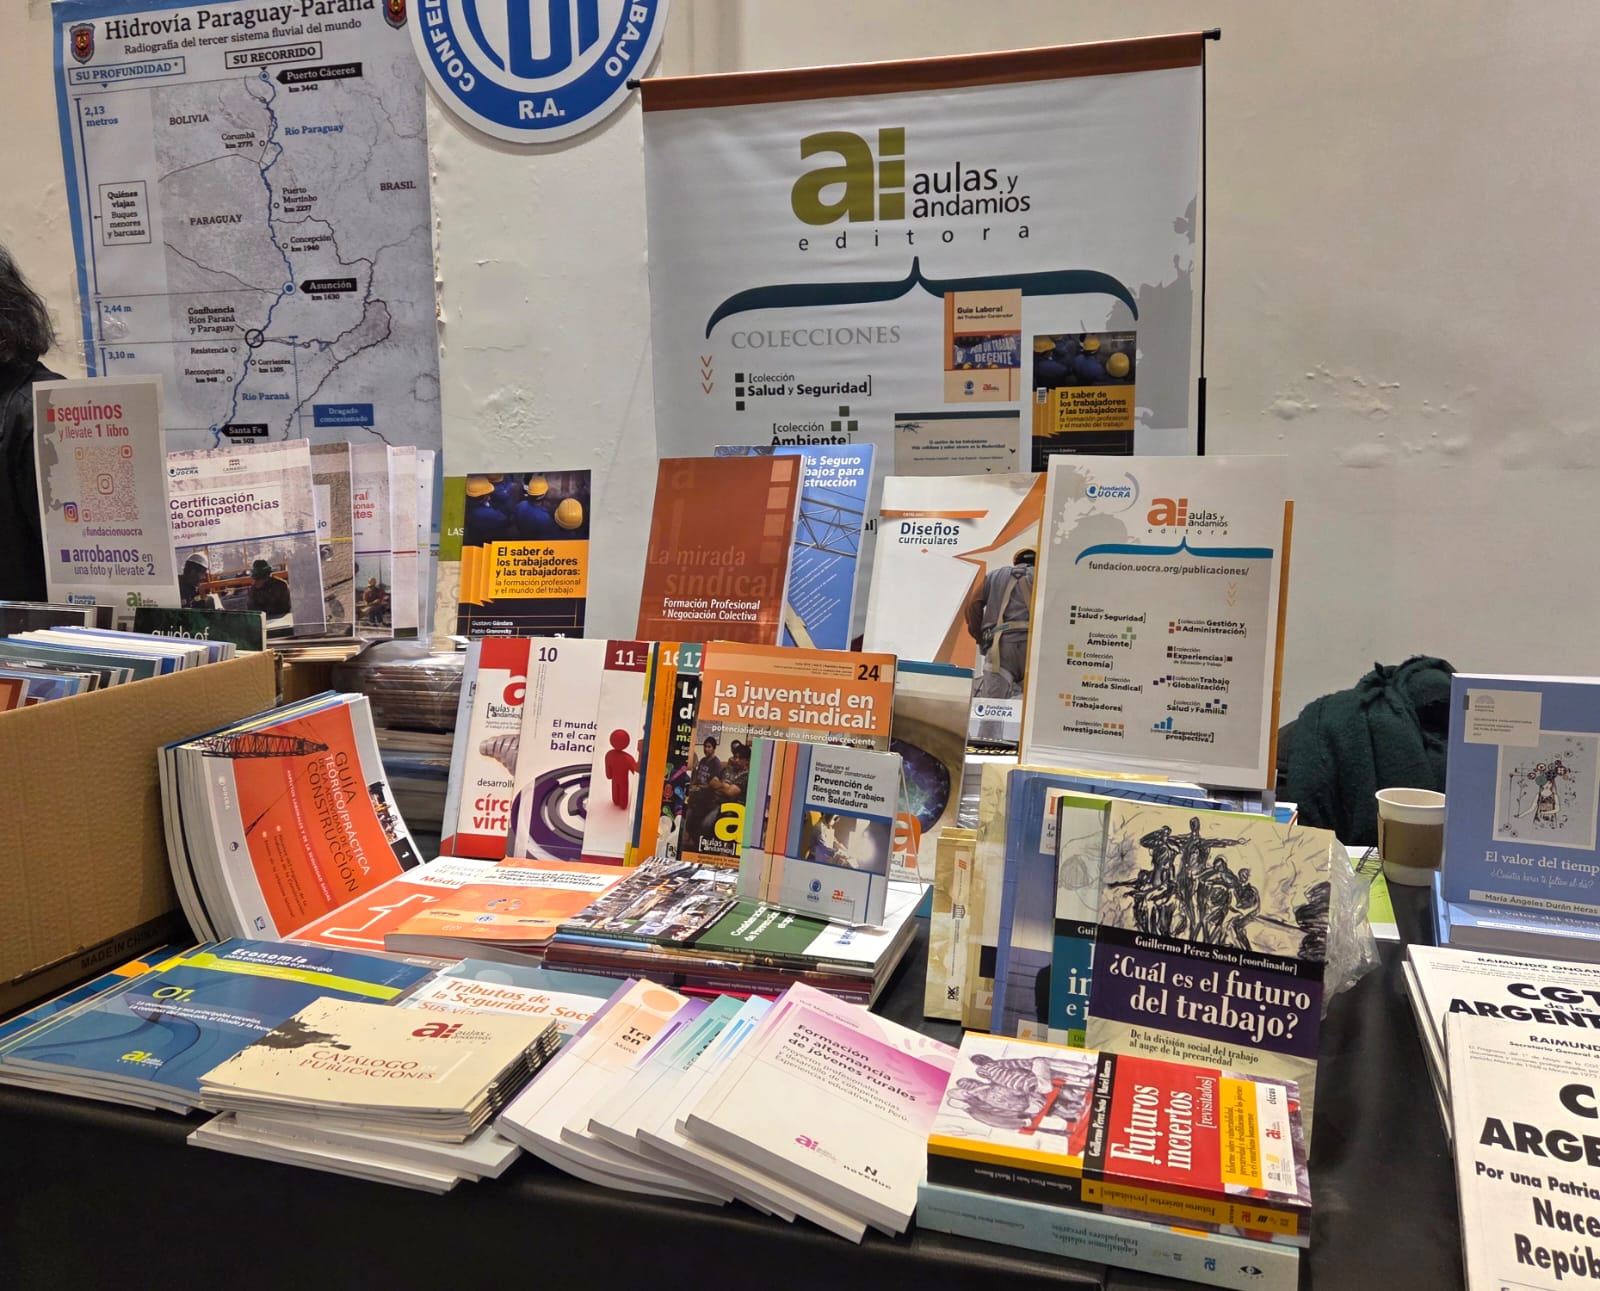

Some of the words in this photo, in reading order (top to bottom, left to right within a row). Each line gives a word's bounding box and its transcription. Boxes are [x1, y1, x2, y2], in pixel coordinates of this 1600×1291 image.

[105, 14, 191, 40] Hidrovía
[124, 40, 179, 54] Radiografía
[182, 38, 197, 48] del
[199, 36, 228, 46] tercer
[231, 30, 269, 43] sistema
[273, 25, 304, 38] fluvial
[307, 23, 322, 34] del
[324, 19, 362, 32] mundo
[605, 0, 648, 77] BAJO
[233, 52, 251, 64] SU
[253, 46, 316, 62] RECORRIDO
[75, 70, 91, 81] SU
[93, 62, 172, 79] PROFUNDIDAD
[286, 70, 315, 81] Puerto
[318, 65, 356, 79] Cáceres
[84, 104, 105, 116] 2,13
[519, 98, 565, 120] R.A.
[86, 115, 118, 127] metros
[169, 113, 209, 126] BOLIVIA
[285, 124, 300, 135] Río
[302, 122, 344, 135] Paraguay
[380, 180, 416, 192] BRASIL
[913, 162, 998, 194] aulas
[1007, 175, 1019, 193] y
[913, 191, 1031, 218] andamios
[190, 213, 242, 226] PARAGUAY
[799, 224, 1030, 250] editora
[310, 279, 352, 291] Asunción
[103, 304, 123, 314] 2,44
[731, 326, 901, 349] COLECCIONES
[108, 350, 126, 361] 3,10
[975, 351, 1012, 365] DECENTE
[748, 385, 785, 396] Salud
[797, 375, 872, 397] Seguridad]
[749, 373, 794, 383] [colección
[242, 392, 257, 401] Río
[259, 391, 290, 401] Paraná
[58, 400, 122, 423] seguínos
[65, 426, 92, 439] llevate
[96, 424, 102, 436] 1
[107, 424, 129, 437] libro
[773, 422, 824, 434] [colección
[819, 455, 861, 469] Seguro
[838, 467, 864, 480] para
[170, 492, 255, 510] Certificación
[1097, 491, 1131, 499] UOCRA
[171, 509, 184, 520] de
[186, 500, 280, 519] competencias
[1188, 510, 1218, 521] aulas
[172, 518, 221, 530] laborales
[900, 521, 960, 537] Diseños
[1188, 519, 1228, 527] andamios
[898, 536, 958, 545] curriculares
[73, 545, 140, 564] arrobanos
[142, 553, 153, 562] en
[498, 547, 508, 557] El
[510, 547, 539, 557] saber
[542, 548, 554, 556] de
[75, 565, 88, 576] una
[90, 565, 105, 575] foto
[115, 564, 145, 575] llevate
[147, 564, 155, 576] 2
[497, 558, 511, 566] los
[513, 557, 578, 568] trabajadores
[1089, 561, 1250, 576] fundacion.uocra.org/publicaciones/
[504, 568, 517, 577] las
[520, 567, 581, 578] trabajadoras:
[503, 578, 539, 587] formación
[541, 578, 581, 587] profesional
[509, 587, 535, 595] mundo
[548, 587, 573, 595] trabajo
[664, 597, 708, 609] Formación
[710, 599, 760, 610] Profesional
[668, 610, 717, 621] Negociación
[719, 610, 757, 621] Colectiva
[1206, 620, 1238, 628] Gestión
[1087, 638, 1132, 649] Ambiente]
[538, 647, 558, 662] 10
[615, 650, 635, 666] 11
[1067, 659, 1114, 670] Economía]
[857, 664, 881, 682] 24
[1082, 681, 1109, 690] Mirada
[715, 679, 737, 699] La
[741, 681, 841, 708] juventud
[847, 694, 874, 710] en
[712, 696, 730, 717] la
[736, 700, 782, 722] vida
[789, 703, 876, 730] sindical:
[985, 709, 1012, 718] UOCRA
[553, 719, 562, 728] El
[567, 730, 575, 739] el
[334, 751, 355, 805] GUÍA
[814, 774, 862, 790] Prevención
[864, 783, 873, 791] de
[811, 794, 826, 803] con
[827, 795, 868, 809] Soldadura
[812, 785, 840, 797] Riesgos
[854, 789, 885, 802] Trabajos
[324, 753, 370, 876] TEÓRICO/PRÁCTICA
[306, 762, 359, 893] CONSTRUCCIÓN
[1486, 851, 1497, 862] El
[1502, 854, 1535, 866] valor
[1538, 856, 1557, 869] del
[1485, 894, 1507, 902] María
[1509, 896, 1543, 907] Ángeles
[1546, 902, 1571, 911] Durán
[1574, 905, 1598, 914] Heras
[1134, 936, 1182, 954] Guillermo
[1183, 944, 1210, 958] Pérez
[1213, 950, 1238, 963] Sosto
[1240, 954, 1298, 974] [coordinador]
[1478, 958, 1548, 968] RAIMUNDO
[1110, 954, 1166, 984] ¿Cuál
[1172, 972, 1194, 988] es
[1200, 972, 1219, 992] el
[1226, 974, 1311, 1010] futuro
[446, 981, 526, 1001] Tributos
[528, 995, 551, 1004] de
[432, 991, 448, 1000] la
[450, 993, 549, 1014] Seguridad
[1130, 987, 1168, 1016] del
[1176, 996, 1300, 1042] trabajo?
[798, 1024, 869, 1062] Formación
[1153, 1032, 1186, 1048] división
[1187, 1039, 1210, 1052] social
[1228, 1046, 1258, 1064] trabajo
[310, 1050, 420, 1071] CATÁLOGO
[792, 1031, 810, 1042] en
[813, 1040, 892, 1081] alternancia
[298, 1058, 435, 1081] PUBLICACIONES
[788, 1038, 806, 1048] de
[808, 1047, 862, 1076] jóvenes
[867, 1075, 917, 1102] rurales
[1196, 1075, 1217, 1129] [revisitados]
[1110, 1085, 1163, 1165] Futuros
[1165, 1091, 1193, 1170] inciertos
[1475, 1161, 1504, 1180] Por
[1510, 1172, 1542, 1188] una
[1548, 1176, 1600, 1201] Patria
